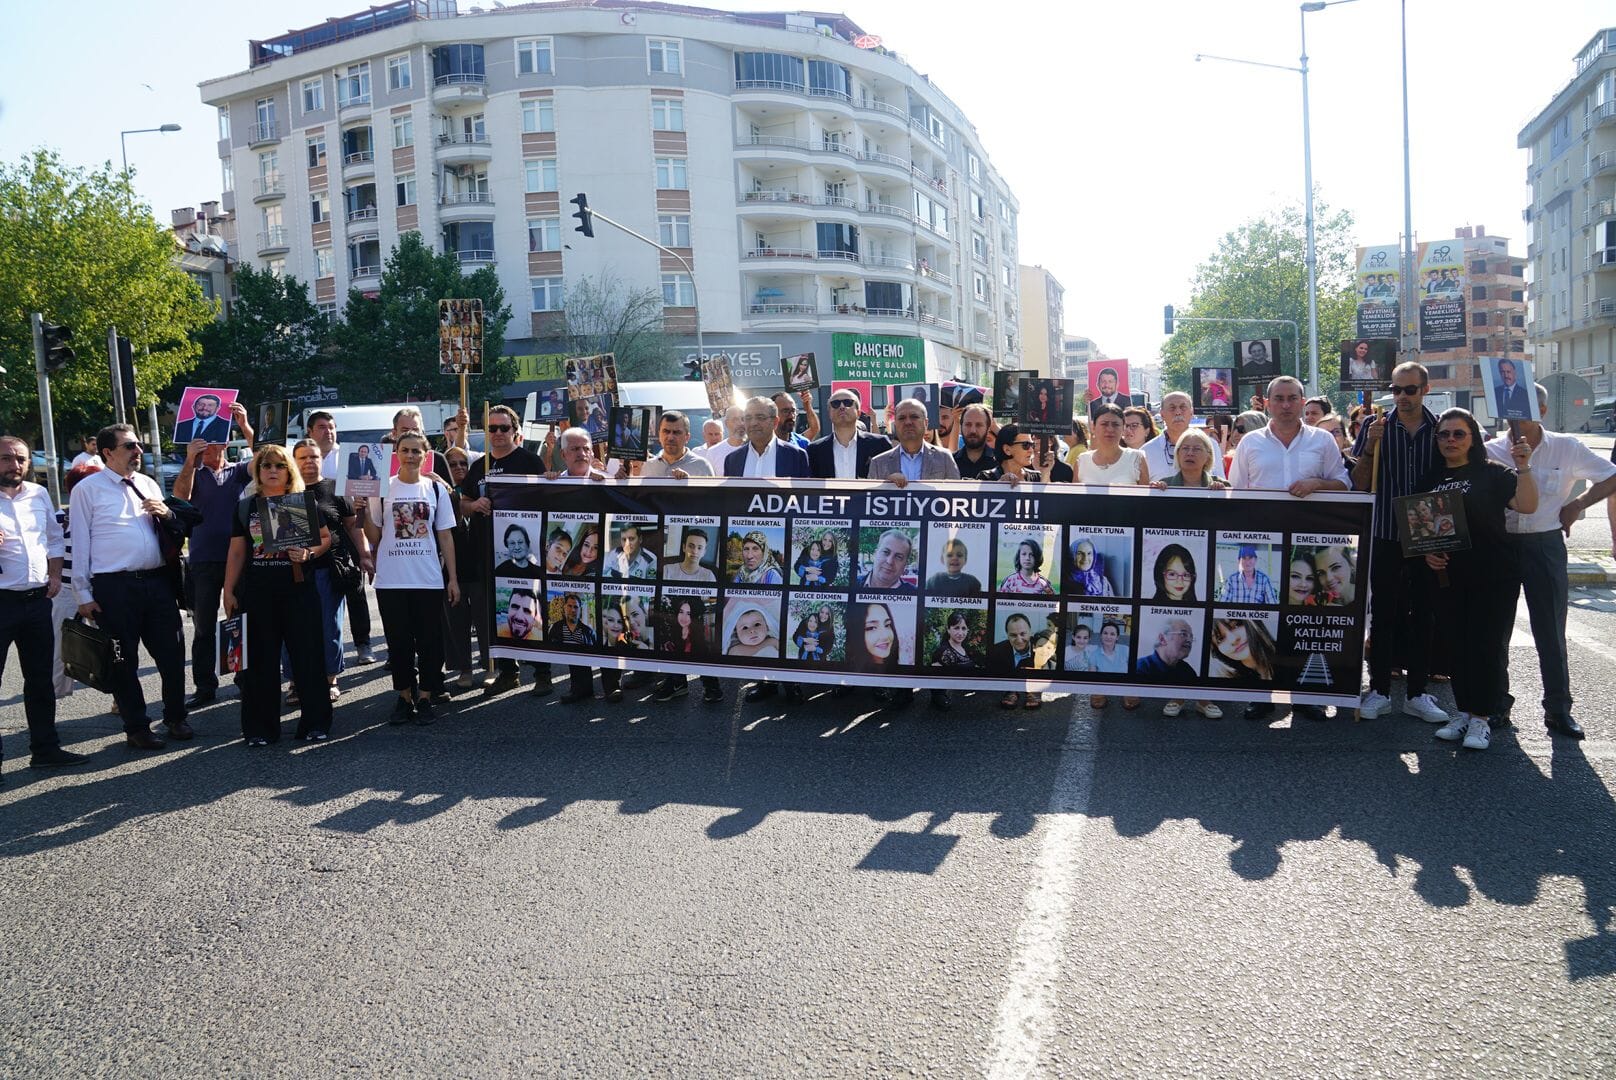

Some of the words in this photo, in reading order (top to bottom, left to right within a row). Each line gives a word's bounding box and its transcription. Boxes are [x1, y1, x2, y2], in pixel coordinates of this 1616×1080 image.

[854, 342, 904, 358] BAHÇEMO
[838, 360, 867, 369] BAHÇE
[748, 494, 850, 514] ADALET
[865, 492, 1006, 518] İSTİYORUZ
[1015, 499, 1039, 519] !!!
[623, 585, 654, 593] KURTULUŞ
[1151, 607, 1173, 615] İRFAN
[1286, 614, 1322, 626] ÇORLU
[1325, 616, 1354, 626] TREN
[1294, 626, 1344, 638] KATLİAMI
[1293, 640, 1342, 652] AİLELERİ
